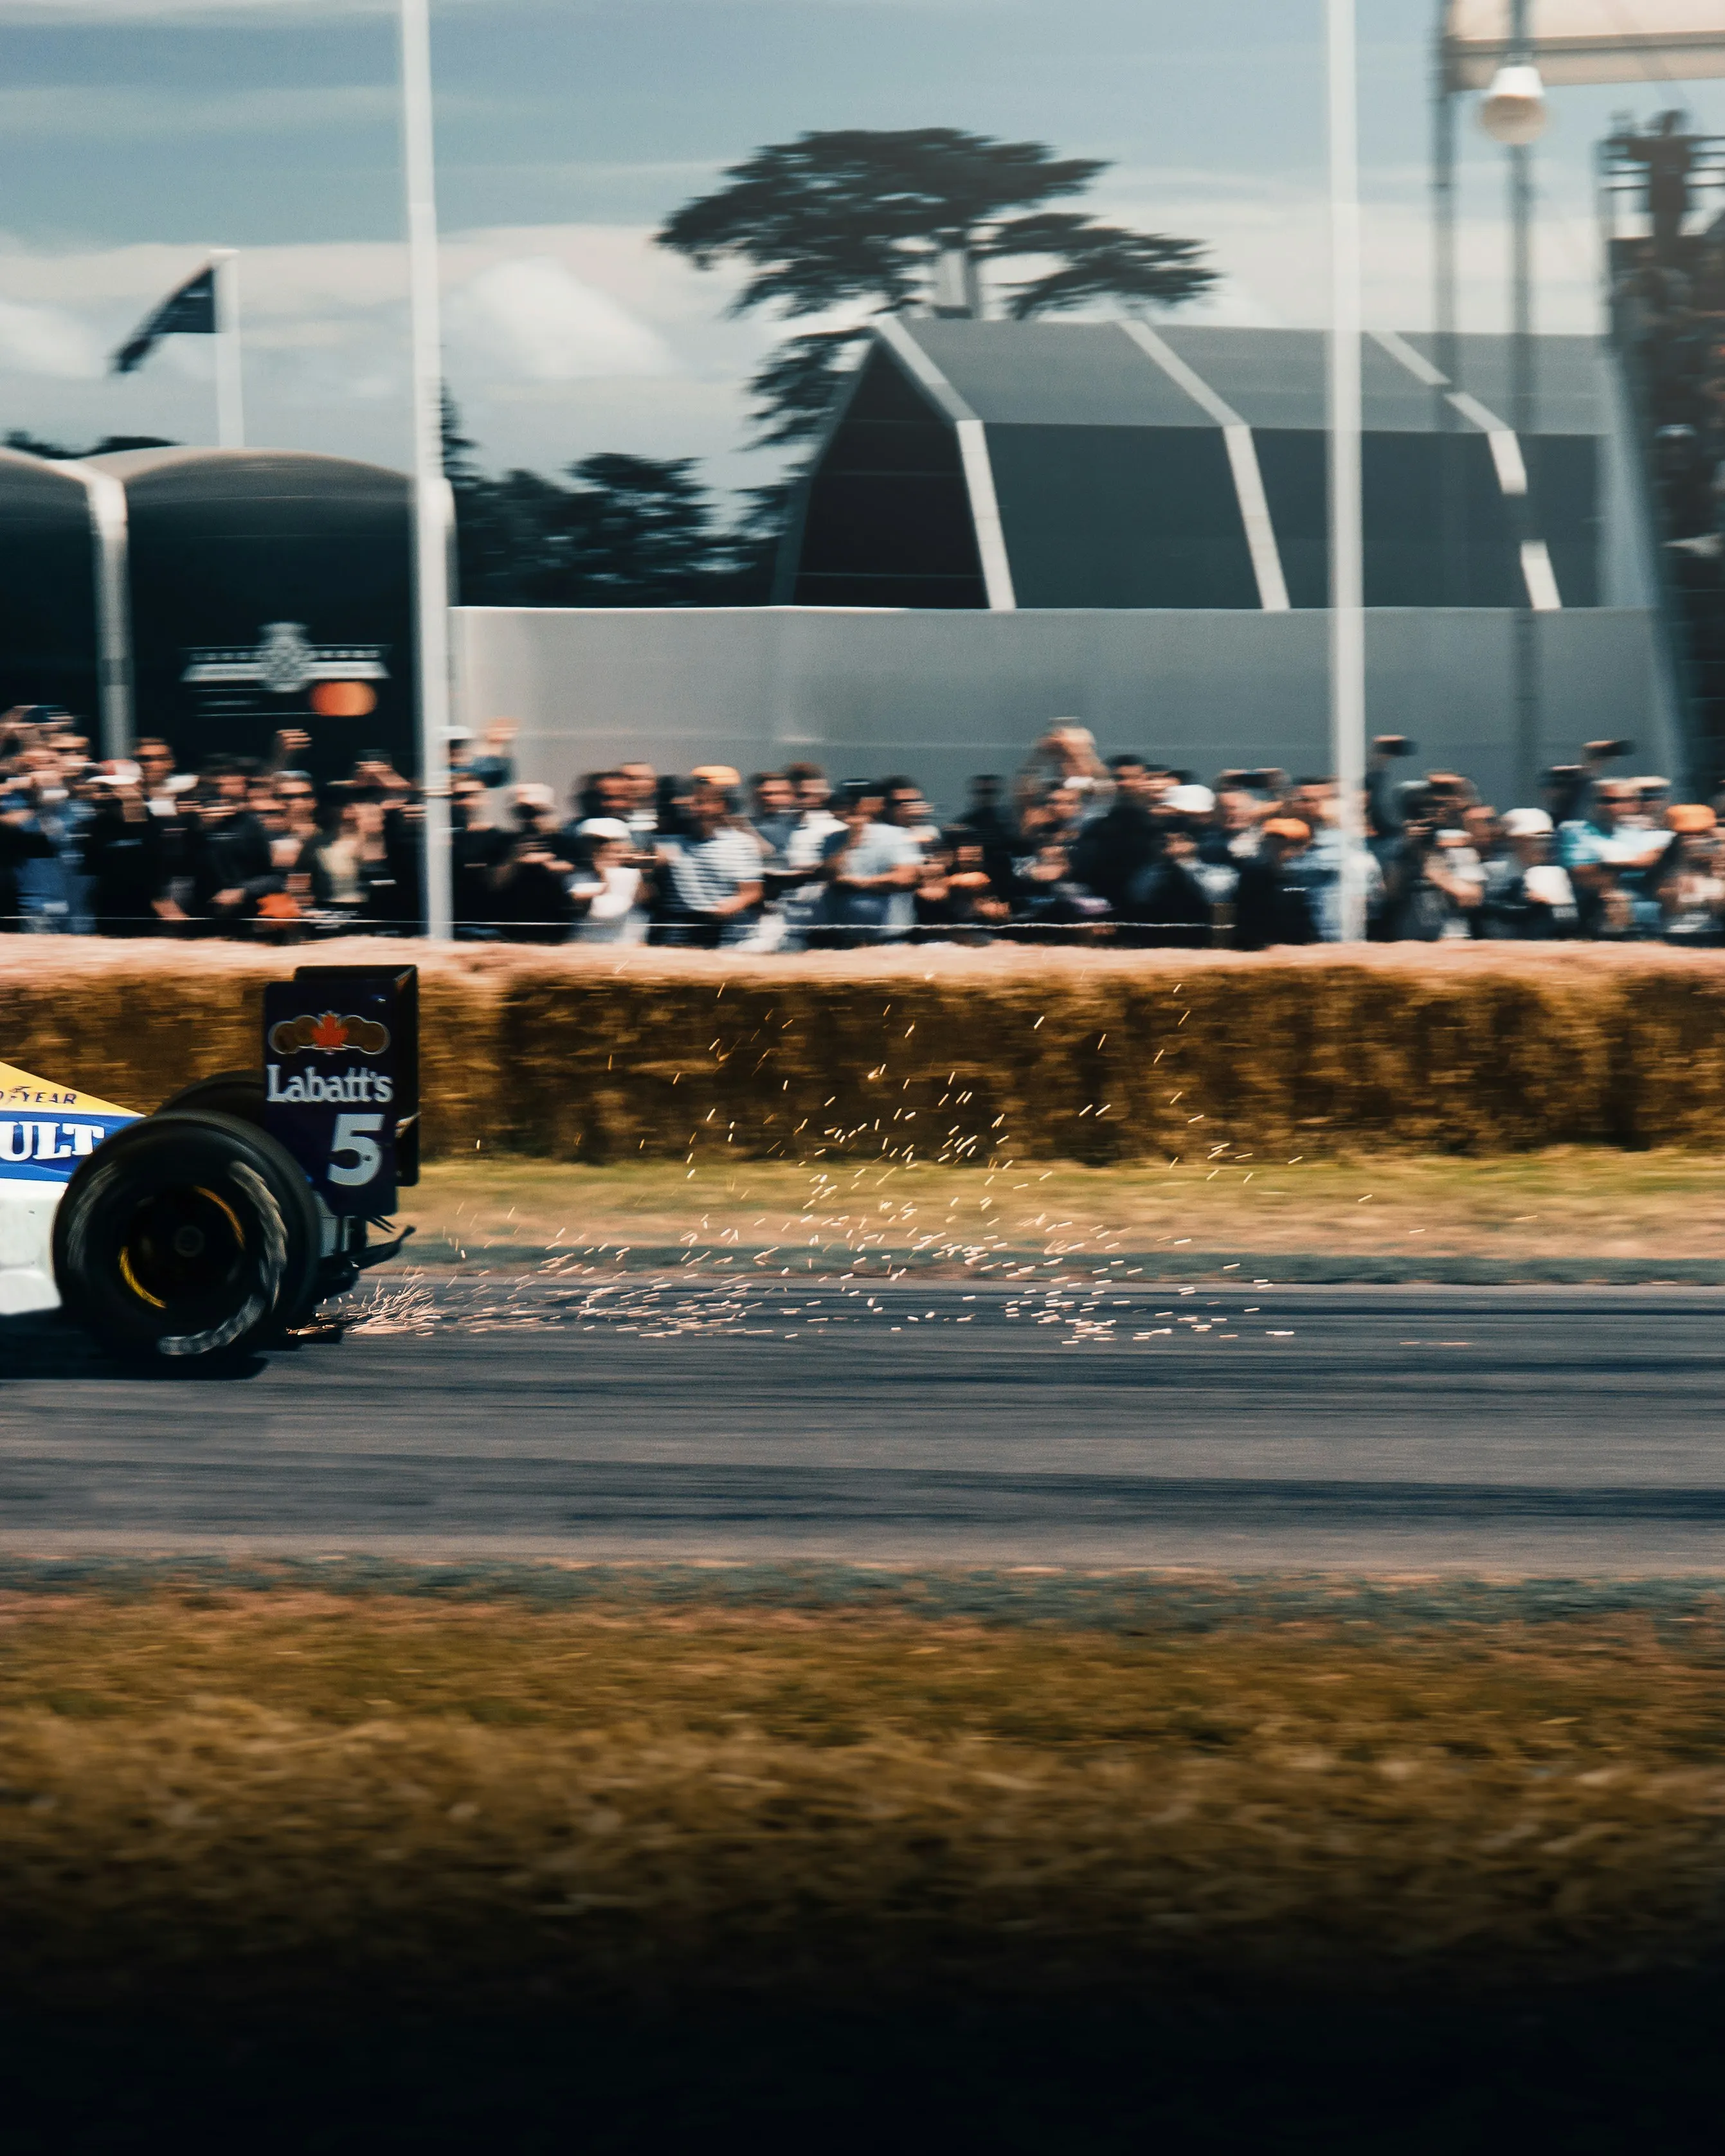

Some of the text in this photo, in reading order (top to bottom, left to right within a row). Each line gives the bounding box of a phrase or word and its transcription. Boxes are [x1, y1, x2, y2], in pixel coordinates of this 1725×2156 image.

[266, 1064, 393, 1103] Labatt's
[0, 1121, 105, 1162] ULT
[327, 1114, 385, 1186] 5
